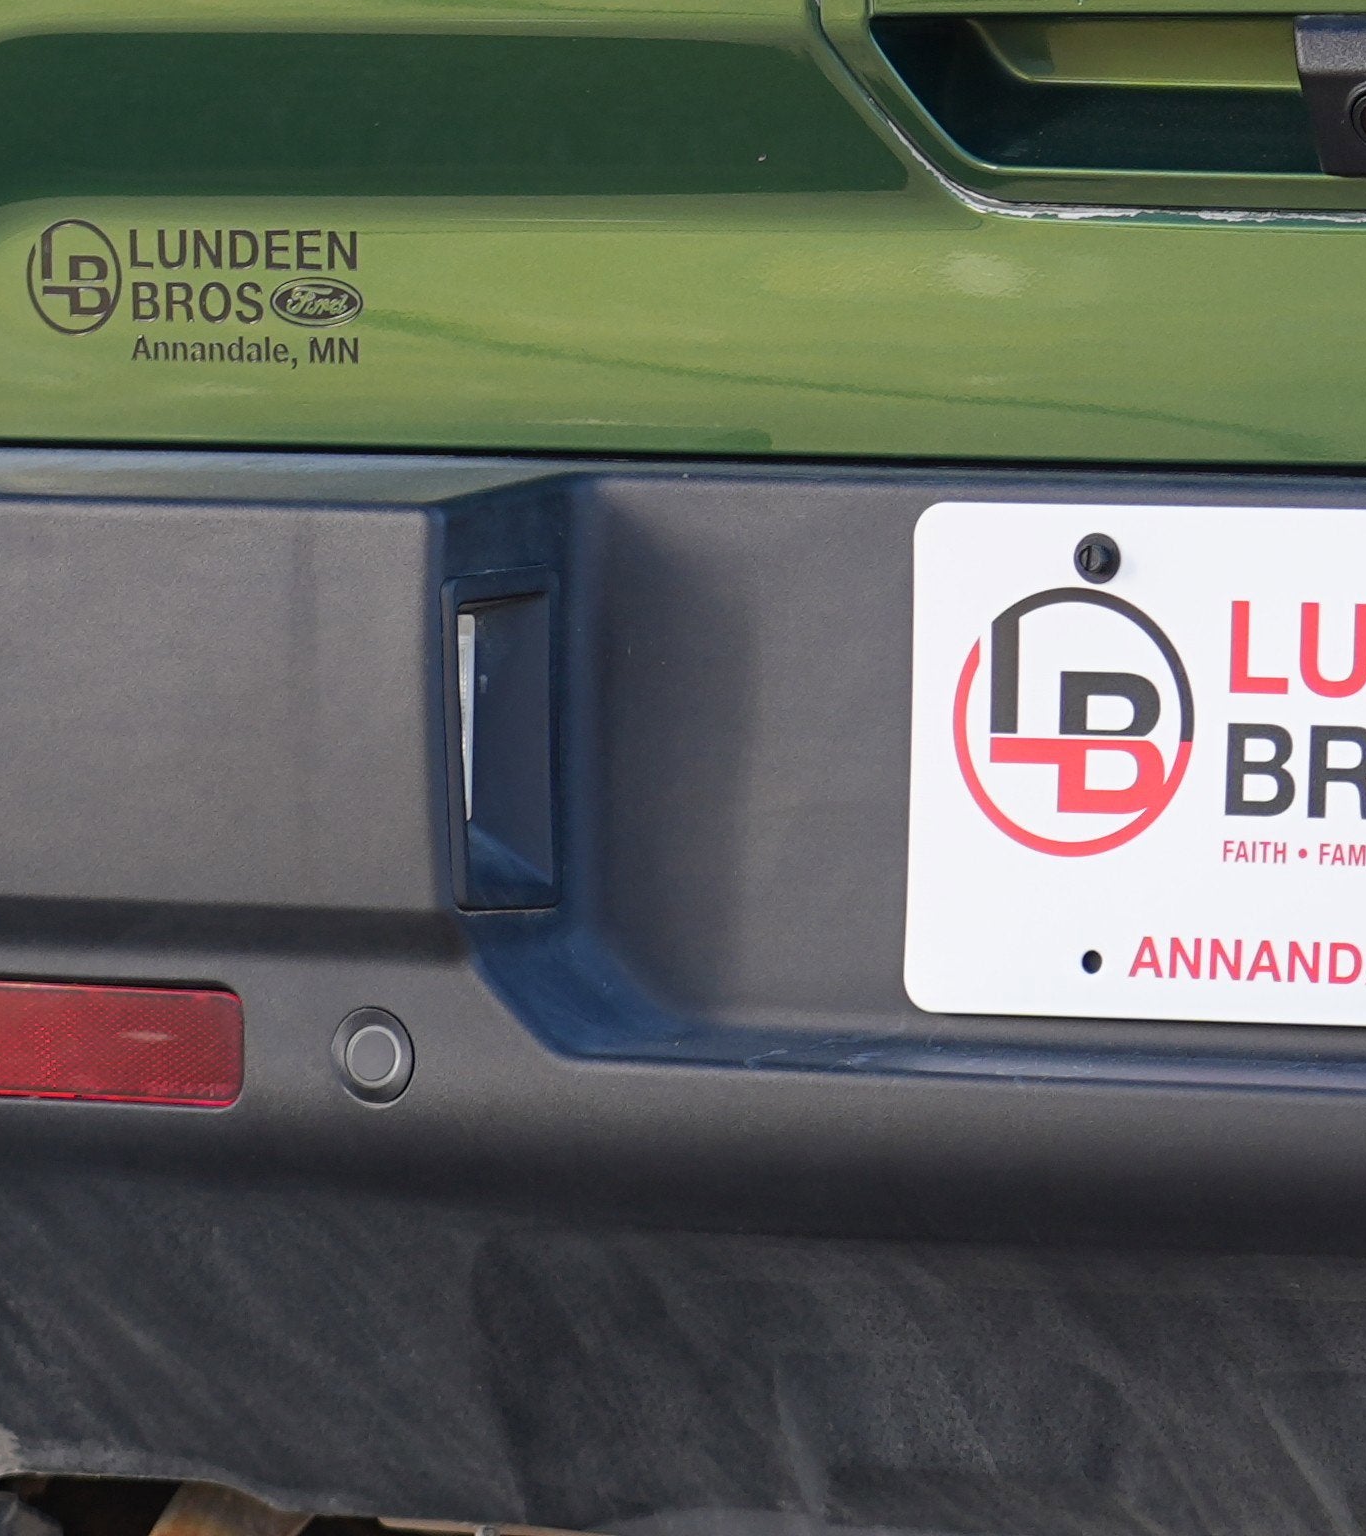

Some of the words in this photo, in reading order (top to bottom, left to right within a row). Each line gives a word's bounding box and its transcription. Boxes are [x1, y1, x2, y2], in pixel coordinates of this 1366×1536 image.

[129, 229, 358, 271] LUNDEEN
[132, 282, 264, 324] BROS
[132, 334, 298, 368] Annandale,
[309, 336, 360, 364] MN
[1222, 840, 1288, 864] FAITH
